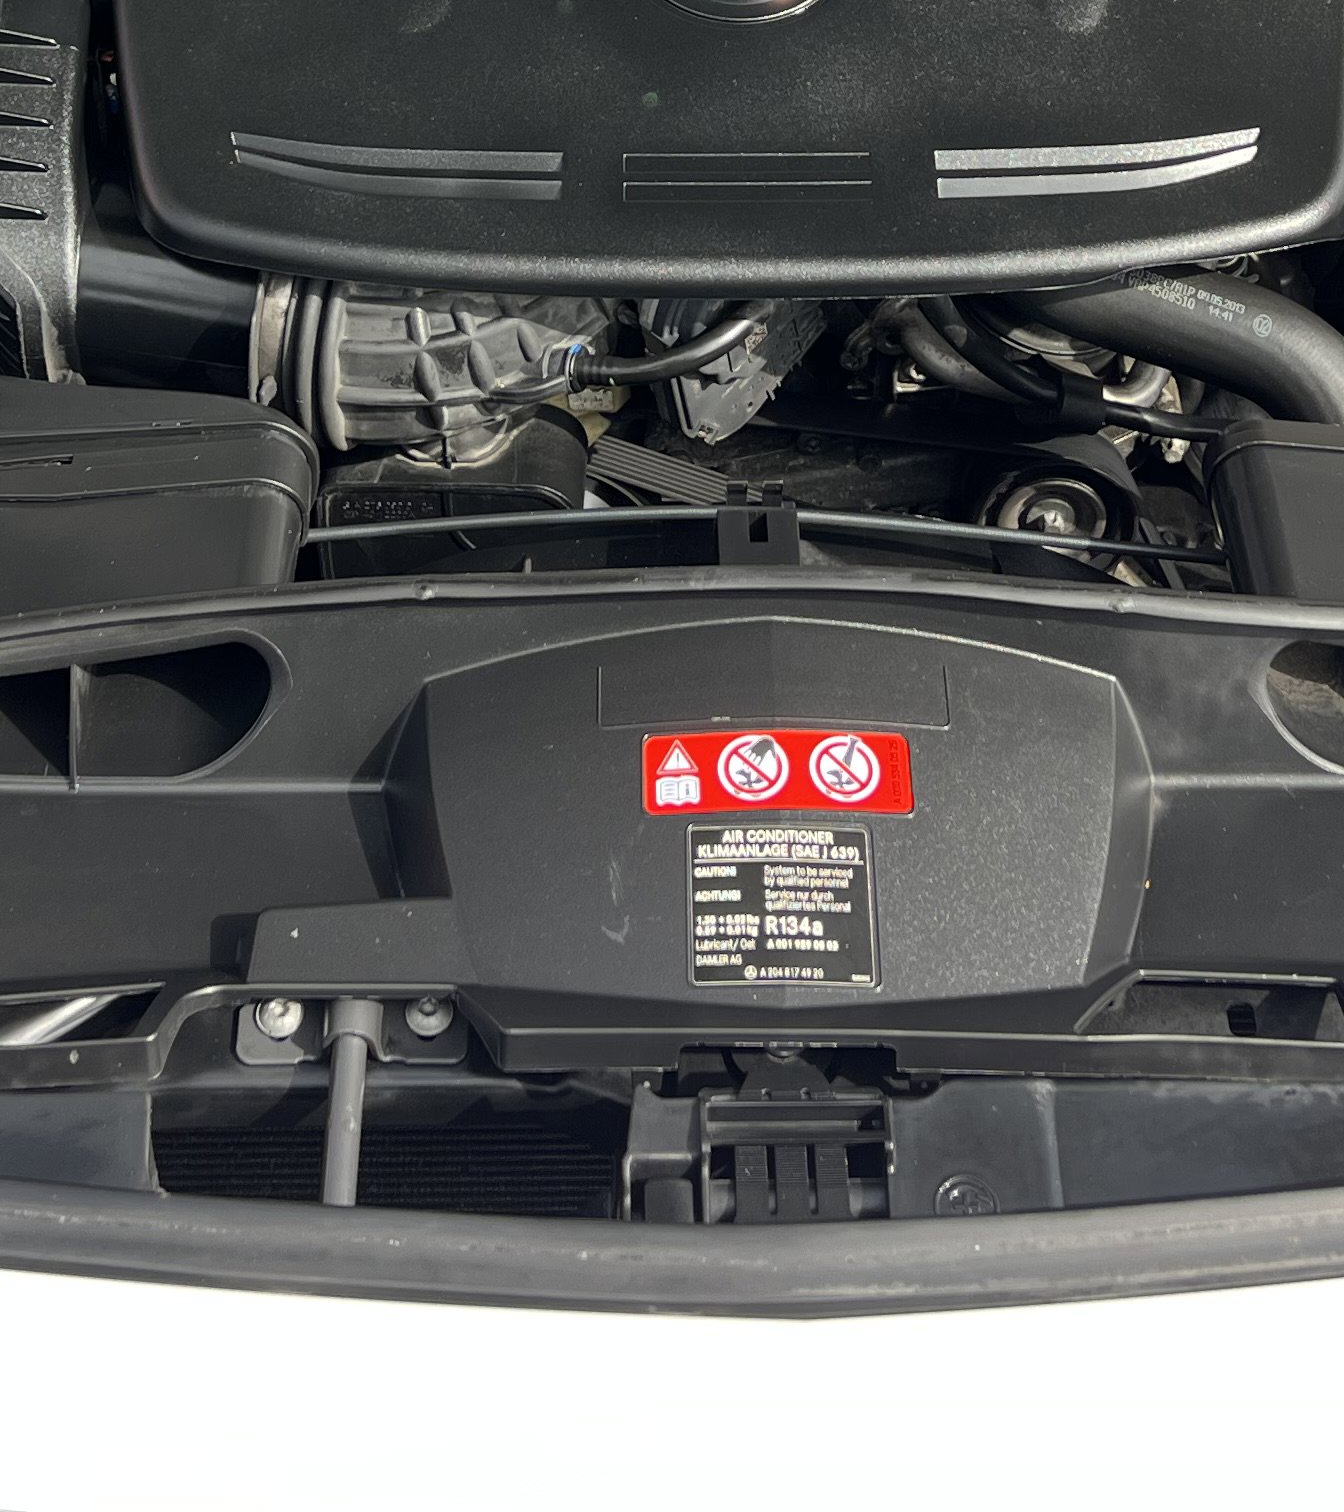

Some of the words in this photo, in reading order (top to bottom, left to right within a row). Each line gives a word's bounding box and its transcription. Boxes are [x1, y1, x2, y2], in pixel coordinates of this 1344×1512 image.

[722, 830, 744, 844] AIR
[747, 830, 834, 845] CONDITIONER
[698, 844, 788, 858] KLIMAANLAGE
[791, 845, 819, 860] (SAE
[822, 846, 827, 859] J
[831, 846, 860, 861] 639)
[763, 864, 795, 878] System
[797, 866, 805, 877] to
[806, 866, 818, 877] be
[818, 867, 853, 879] serviced
[764, 875, 775, 887] by
[777, 876, 809, 888] qualified
[810, 877, 850, 889] personnel
[765, 889, 795, 901] Service
[797, 891, 811, 901] nur
[811, 890, 835, 902] durch
[816, 901, 852, 913] Personal
[765, 915, 824, 936] R134a
[766, 940, 775, 950] A
[730, 953, 742, 965] AG
[759, 967, 767, 978] A
